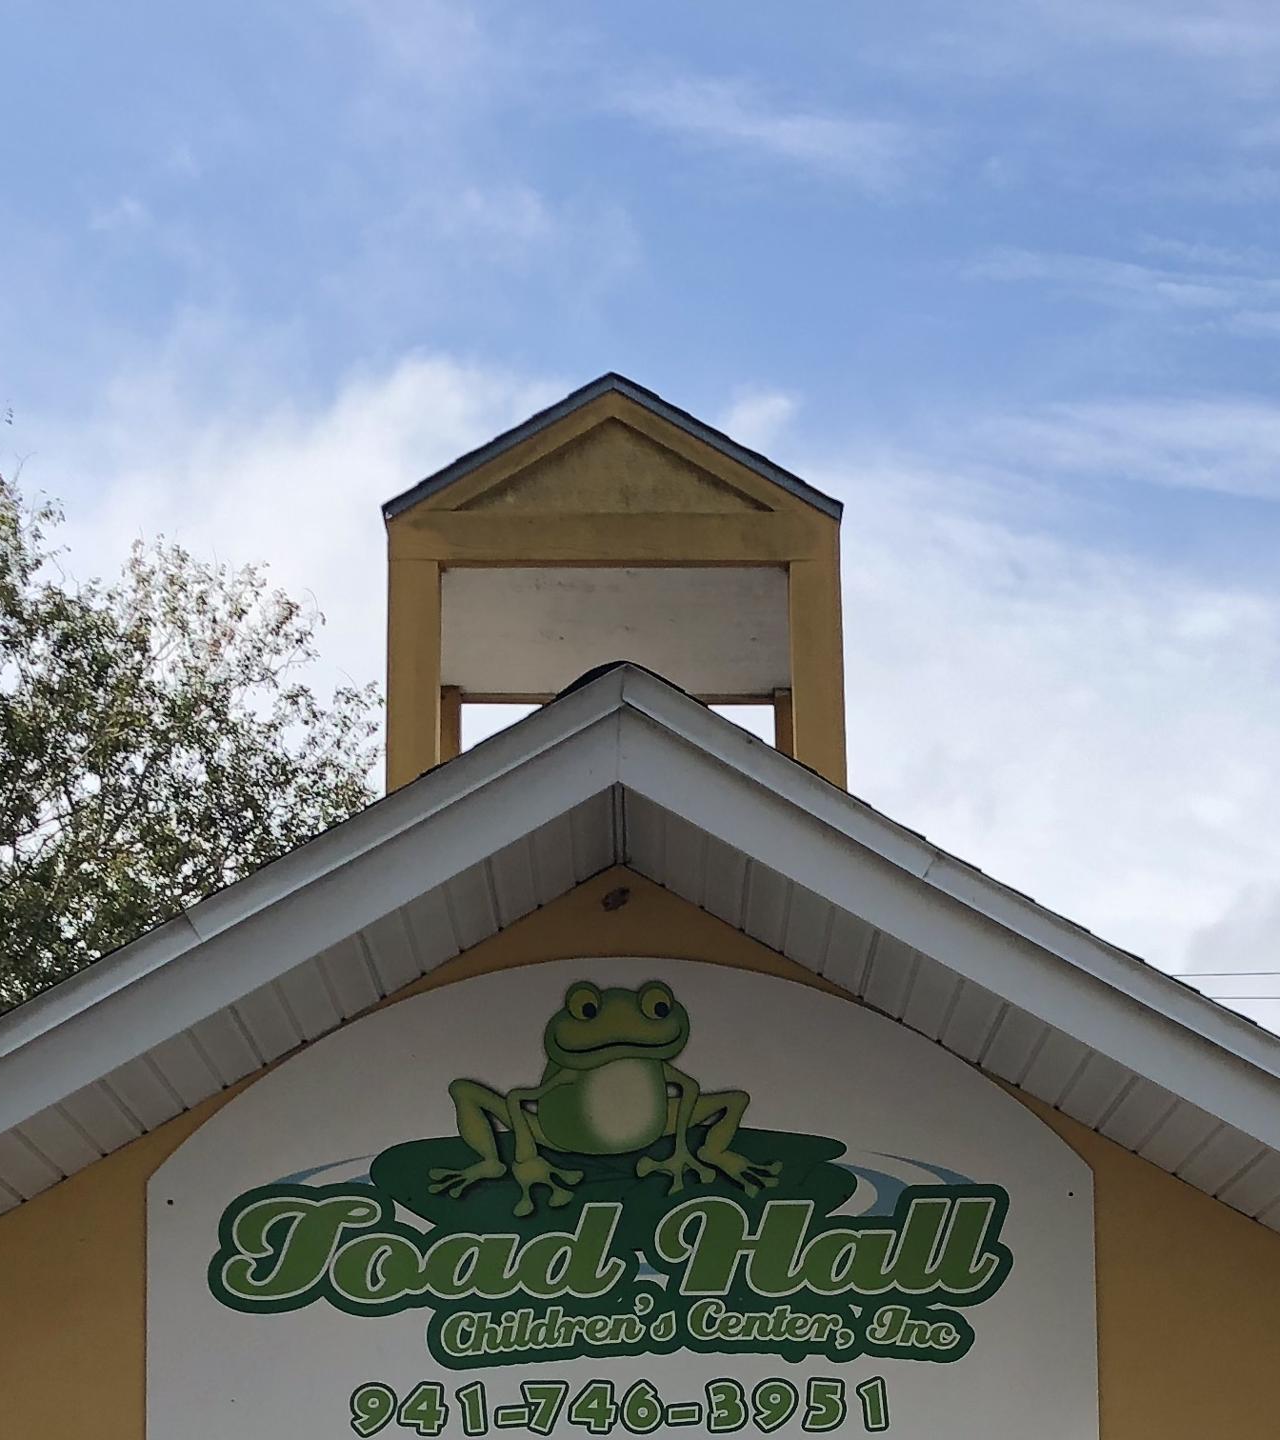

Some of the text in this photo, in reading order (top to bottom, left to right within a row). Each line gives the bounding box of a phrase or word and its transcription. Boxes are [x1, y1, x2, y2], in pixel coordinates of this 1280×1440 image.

[222, 1196, 999, 1303] Toad Hall
[442, 1294, 959, 1356] Children's Center, Inc
[350, 1377, 889, 1437] 941-746-3951
